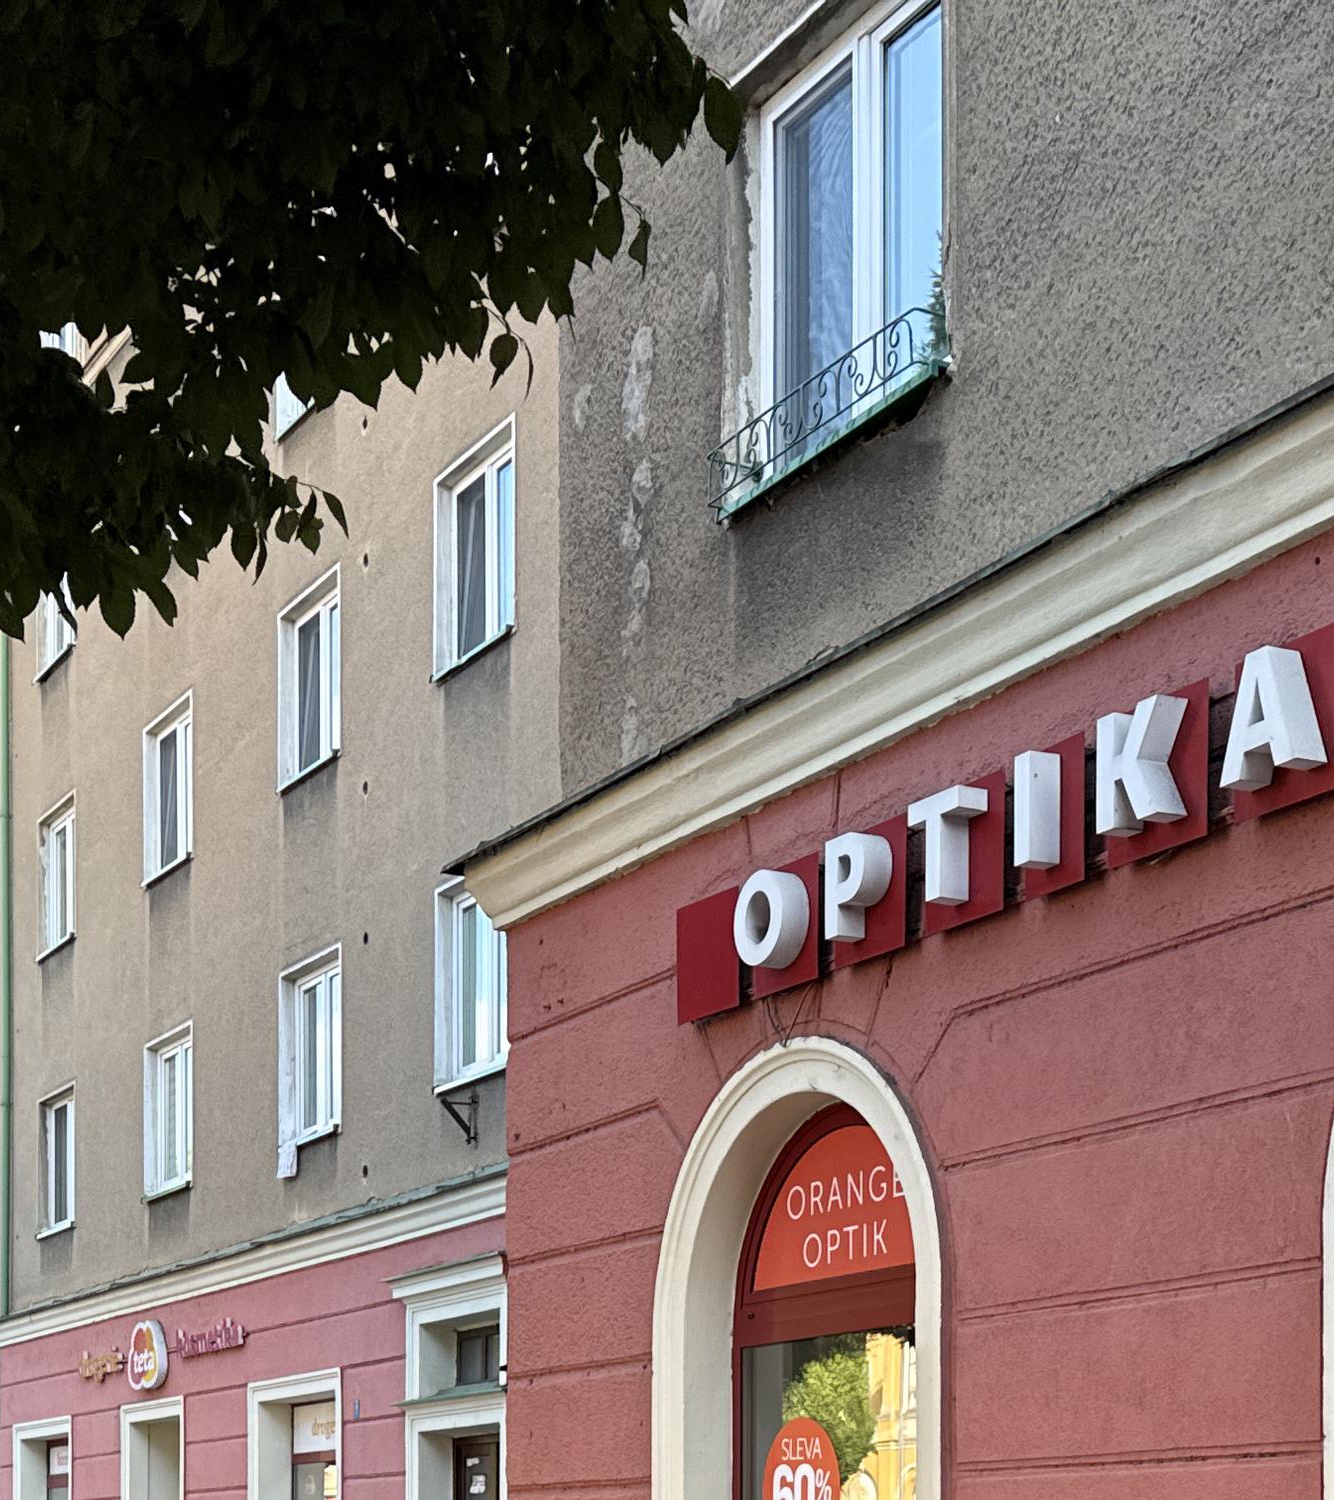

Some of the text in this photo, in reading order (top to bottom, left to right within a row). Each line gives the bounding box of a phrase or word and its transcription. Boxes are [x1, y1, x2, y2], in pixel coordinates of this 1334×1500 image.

[733, 645, 1328, 968] OPTIKA
[803, 1219, 888, 1268] OPTIK
[133, 1349, 155, 1374] teta
[781, 1437, 823, 1461] SLEVA
